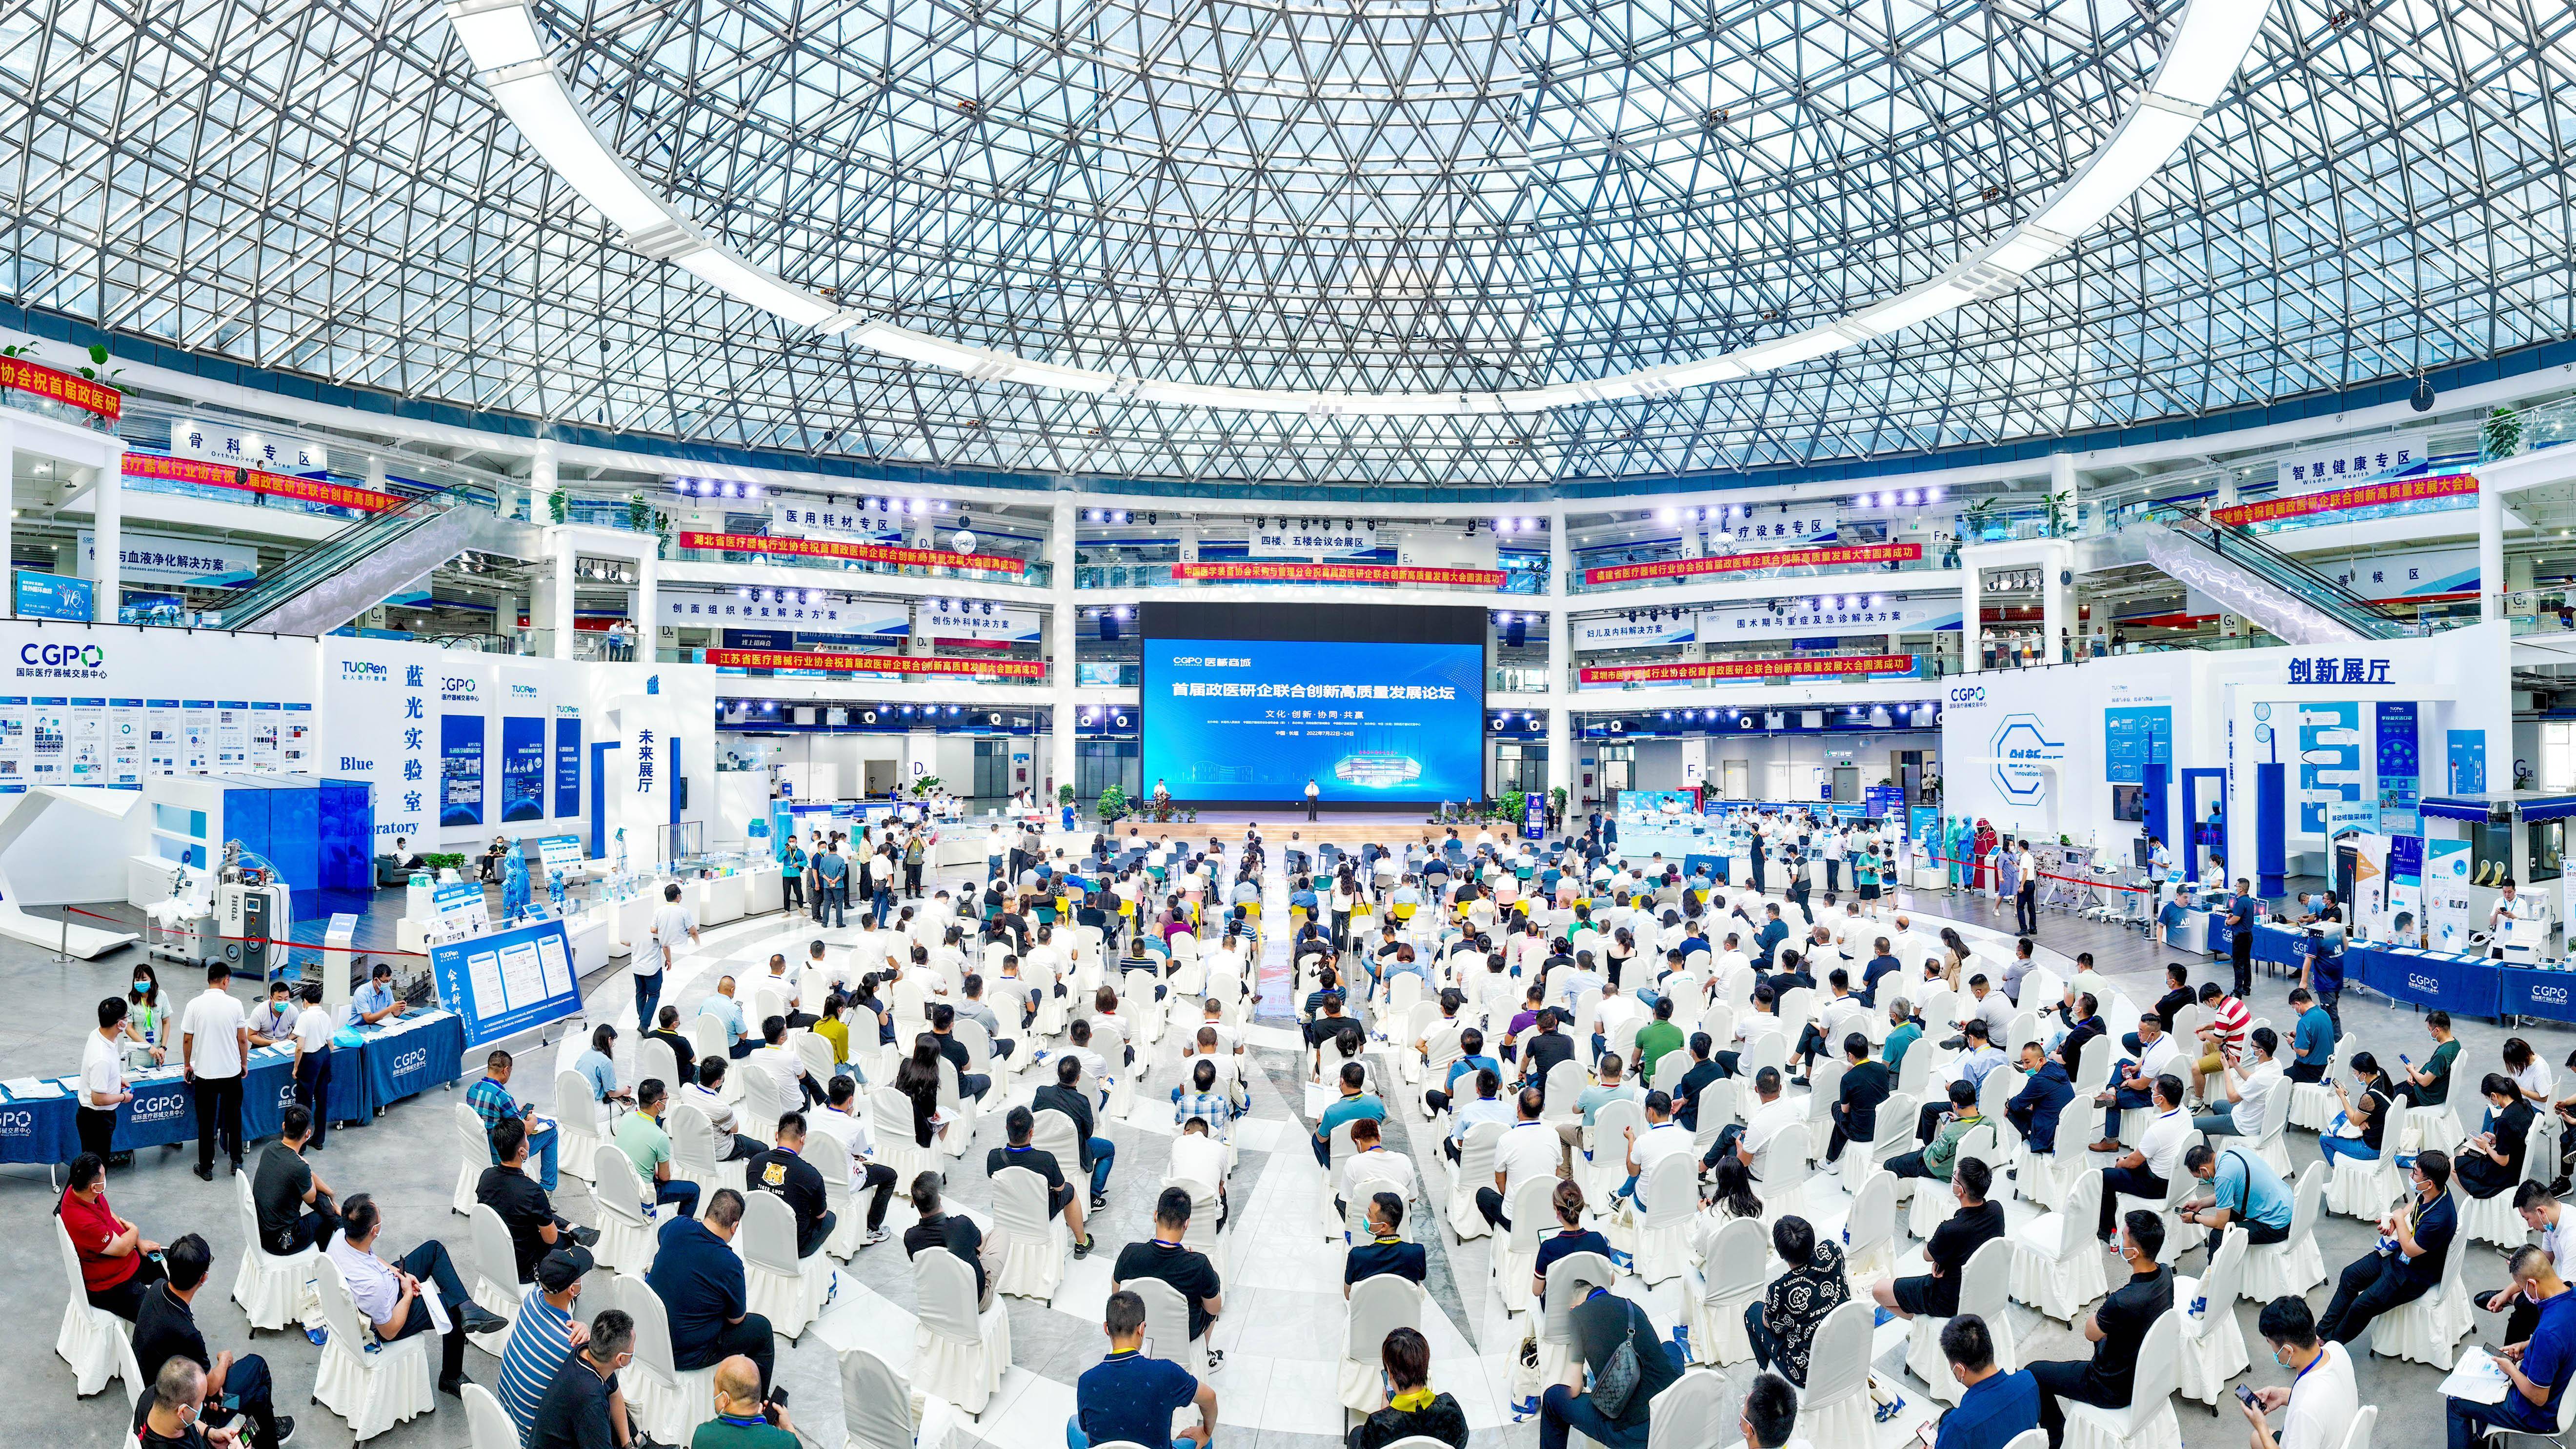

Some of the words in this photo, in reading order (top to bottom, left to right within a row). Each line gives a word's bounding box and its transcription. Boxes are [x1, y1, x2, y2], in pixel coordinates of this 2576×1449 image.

[0, 362, 117, 414] 协会祝首届政医研
[189, 432, 310, 466] 骨科专区
[273, 461, 291, 469] Area
[2293, 450, 2410, 481] 智慧健康专区
[121, 455, 406, 511] 医疗器械行业协会祝届政医研企联合创新高质量发
[2303, 476, 2333, 485] Wisdom
[2214, 477, 2479, 523] 行业协会祝首届政医研企联合创新高质量发展大会圆
[786, 510, 888, 531] 医用耗材专区
[1261, 536, 1364, 547] 四楼、五楼会议会展区
[694, 534, 1017, 570] 湖北省医疗器械行业协会祝首届政医研企联合创新高质量发展大会圆满成功
[1596, 546, 1912, 581] 福建省医疗器械行业协会祝首届政医研企联合创新高质量发展大会圆满成功
[1184, 566, 1499, 584] 中国医学装备协会采购与管理分会祝首届政医研企联合创新高质量发展大会圆满成功
[673, 604, 837, 620] 创面组织修复解决方案
[1737, 611, 1901, 628] 围术期与重症及急诊解决方案
[932, 616, 1009, 629] 创伤外科解决方案
[1587, 624, 1663, 638] 妇儿及内科解决方案
[741, 639, 772, 647] 线上招商会
[21, 644, 103, 667] CGPO
[1205, 658, 1251, 667] 医械商城
[342, 662, 386, 674] TUORen
[720, 653, 1038, 675] 江苏省医疗器械行业协会祝首届政医研企联合创新高质量发展大会圆满成功
[1590, 658, 1904, 681] 深圳市医疗器械行业协会祝首届政医研企联合创新高质量发展大会圆满成功
[2288, 657, 2390, 682] 创新展厅
[17, 668, 107, 679] 国际医疗器械交易中心
[1172, 683, 1455, 700] 首届政医研企联合创新高质量发展论坛
[1951, 686, 1985, 702] CGPO
[404, 664, 424, 812] 蓝光实验室
[340, 756, 373, 771] Blue
[637, 729, 654, 793] 未来展厅
[2332, 813, 2373, 822] 移动核酸采样亭
[1884, 864, 1894, 873] 24
[440, 950, 459, 959] TUORen
[2409, 972, 2438, 988] CGPO
[2531, 994, 2567, 1003] 国际医疗器械交易中心
[2532, 985, 2568, 999] CGPO
[394, 1047, 426, 1069] CGPO
[393, 1060, 426, 1076] 国际医疗器械交易中心
[134, 1094, 184, 1113] CGPO
[131, 1109, 185, 1121] 国际医疗器械交易中心
[1784, 1276, 1818, 1288] LUCKYTIGER
